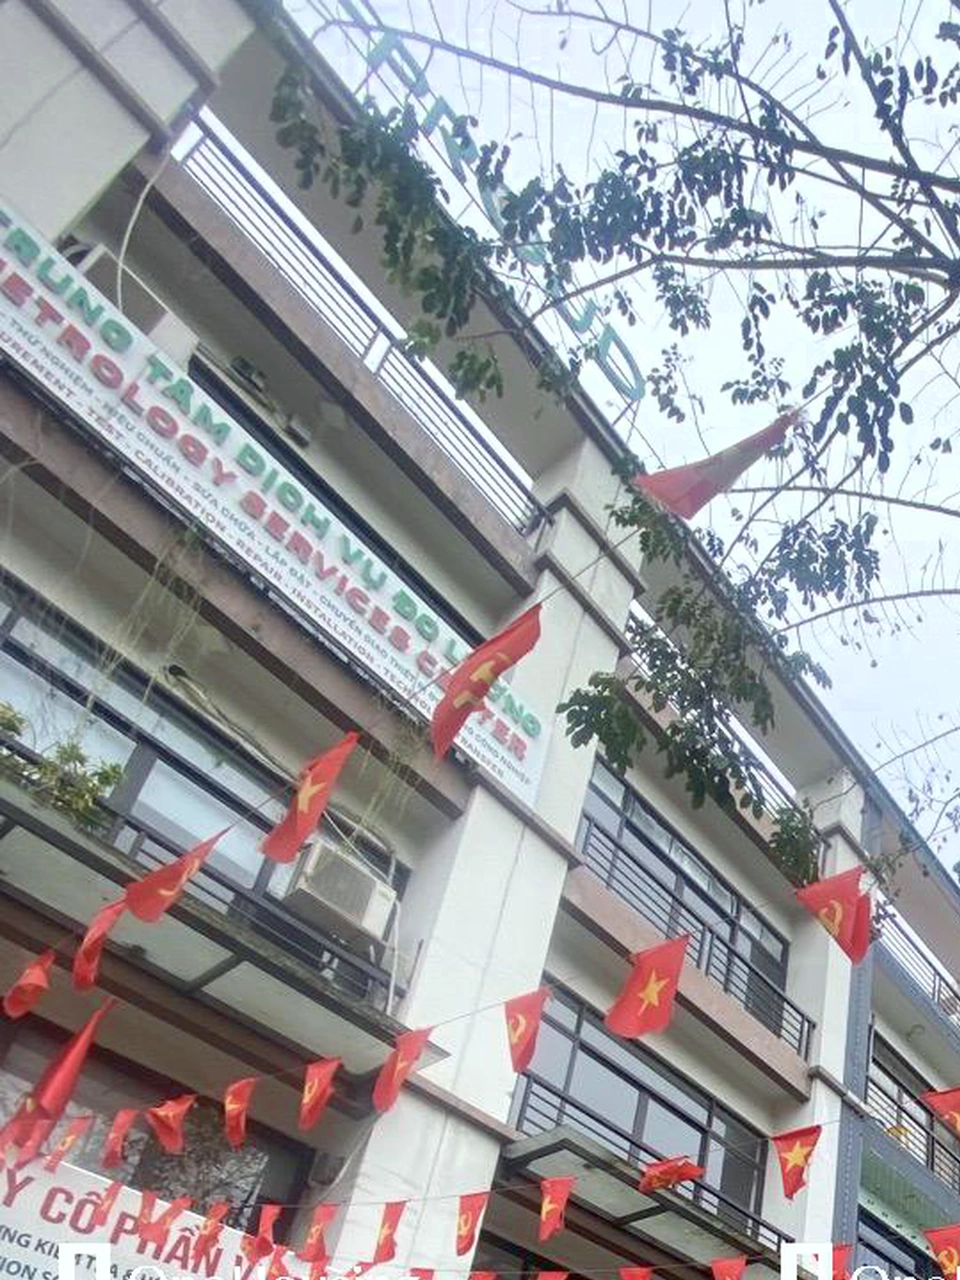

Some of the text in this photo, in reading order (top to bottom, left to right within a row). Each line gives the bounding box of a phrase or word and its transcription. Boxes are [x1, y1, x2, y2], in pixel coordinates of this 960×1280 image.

[0, 208, 133, 353] RUNG
[0, 252, 528, 763] ETROLOGY SERVICES CETER
[0, 1223, 32, 1250] NG
